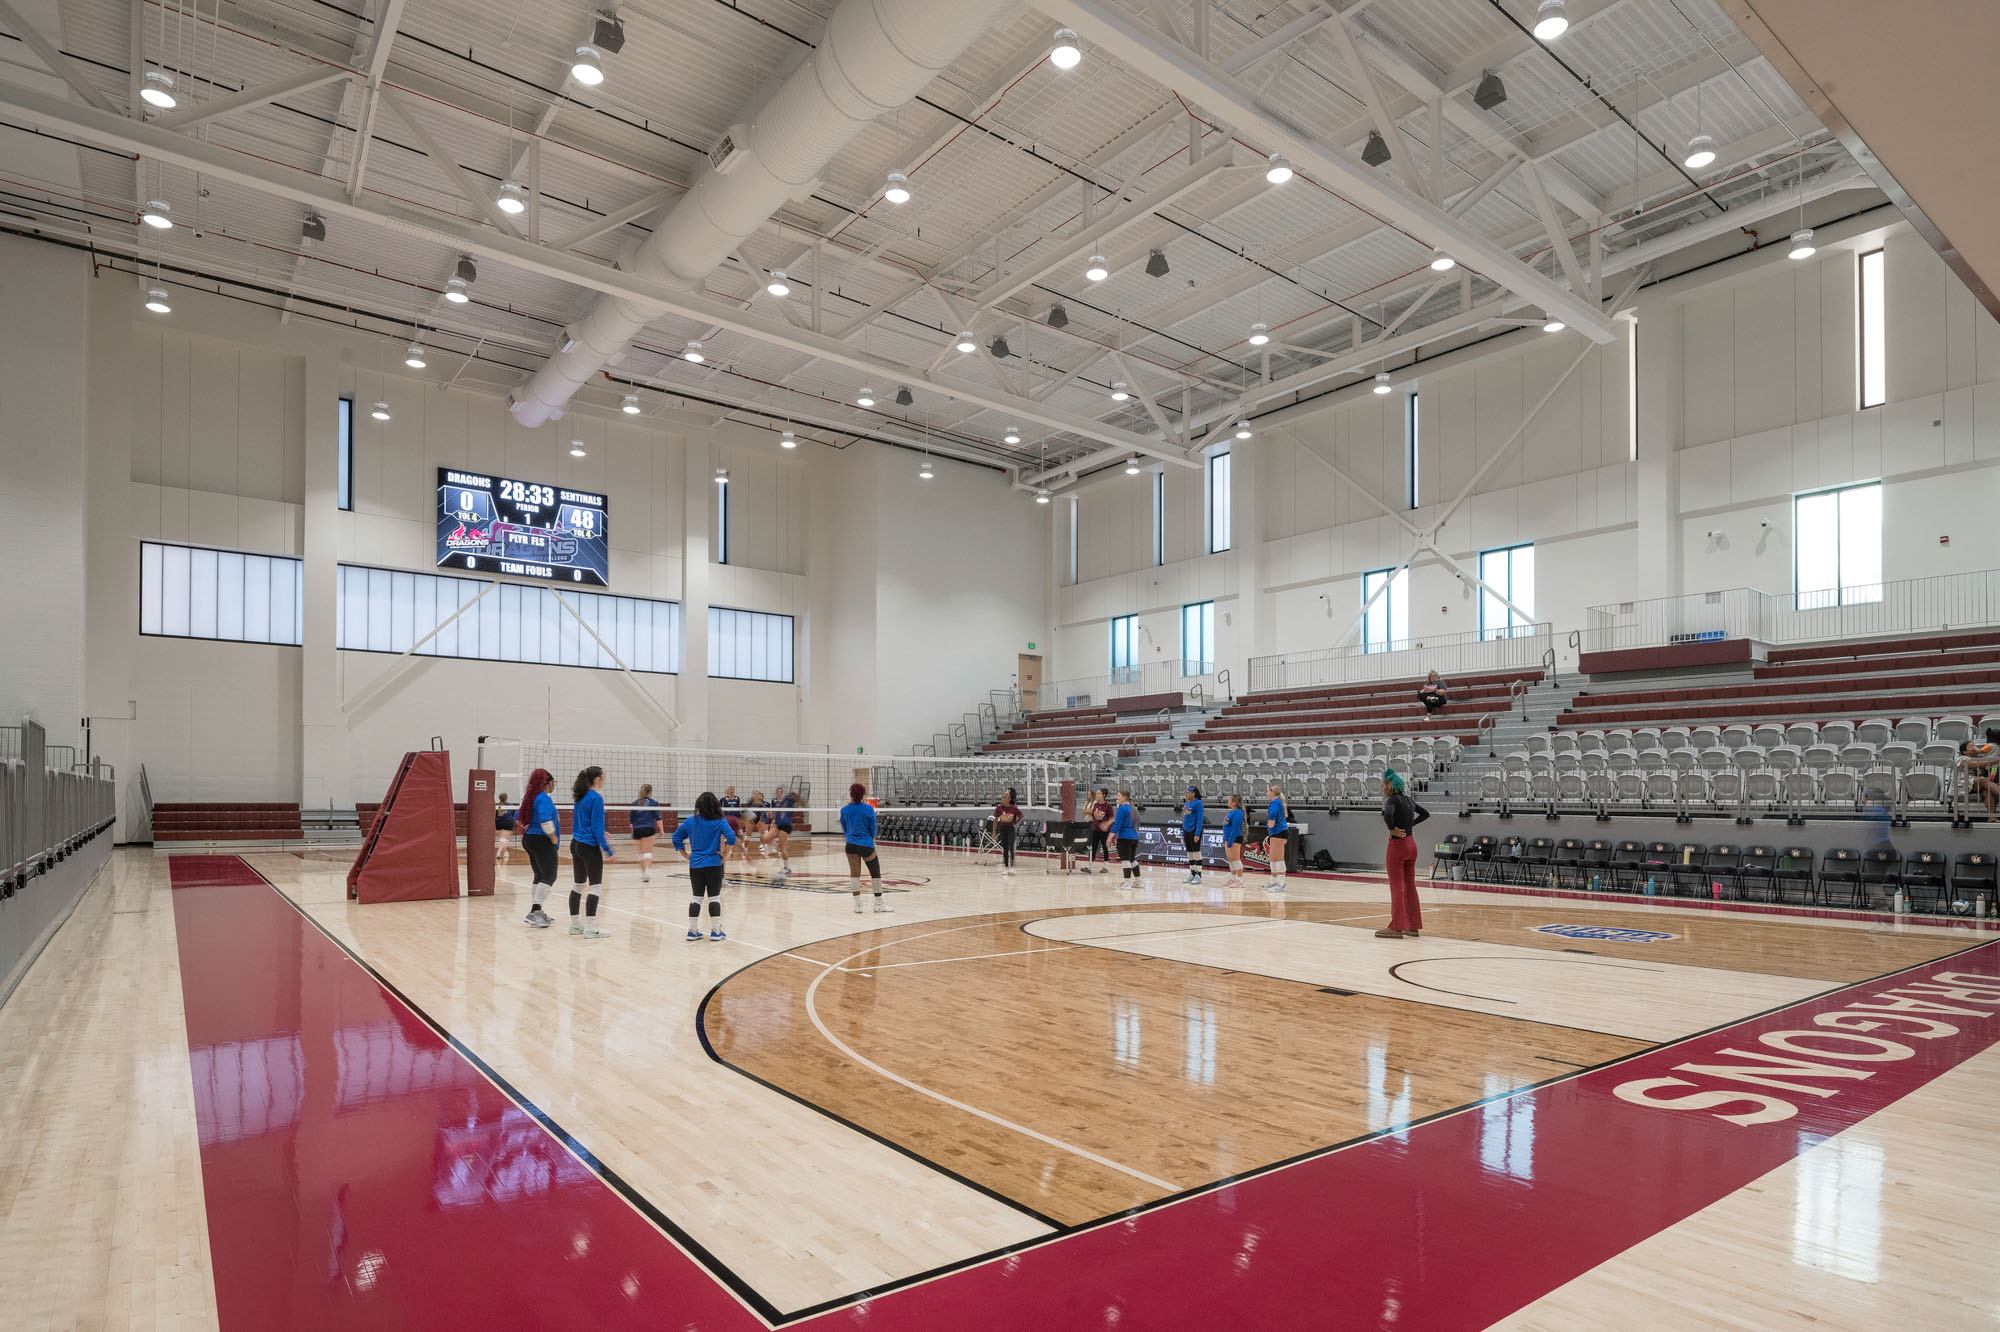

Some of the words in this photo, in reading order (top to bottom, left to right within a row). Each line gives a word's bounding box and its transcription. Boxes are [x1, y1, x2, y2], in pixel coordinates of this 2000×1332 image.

[447, 471, 491, 488] DRAGONS
[500, 479, 554, 507] 28:33
[560, 490, 602, 506] SENTINALS
[460, 491, 474, 511] 0
[516, 503, 540, 513] PERIOD
[458, 511, 470, 521] TOL
[524, 513, 531, 525] 1
[570, 508, 594, 530] 48
[573, 529, 585, 537] TOL
[445, 538, 490, 547] DRAGONS
[508, 533, 529, 544] PLYR
[531, 535, 545, 547] FLS
[466, 556, 476, 569] 0
[500, 562, 525, 574] TEAM
[525, 564, 553, 577] FOULS
[573, 569, 582, 582] 0
[1145, 832, 1153, 840] 0
[1208, 835, 1223, 843] 48
